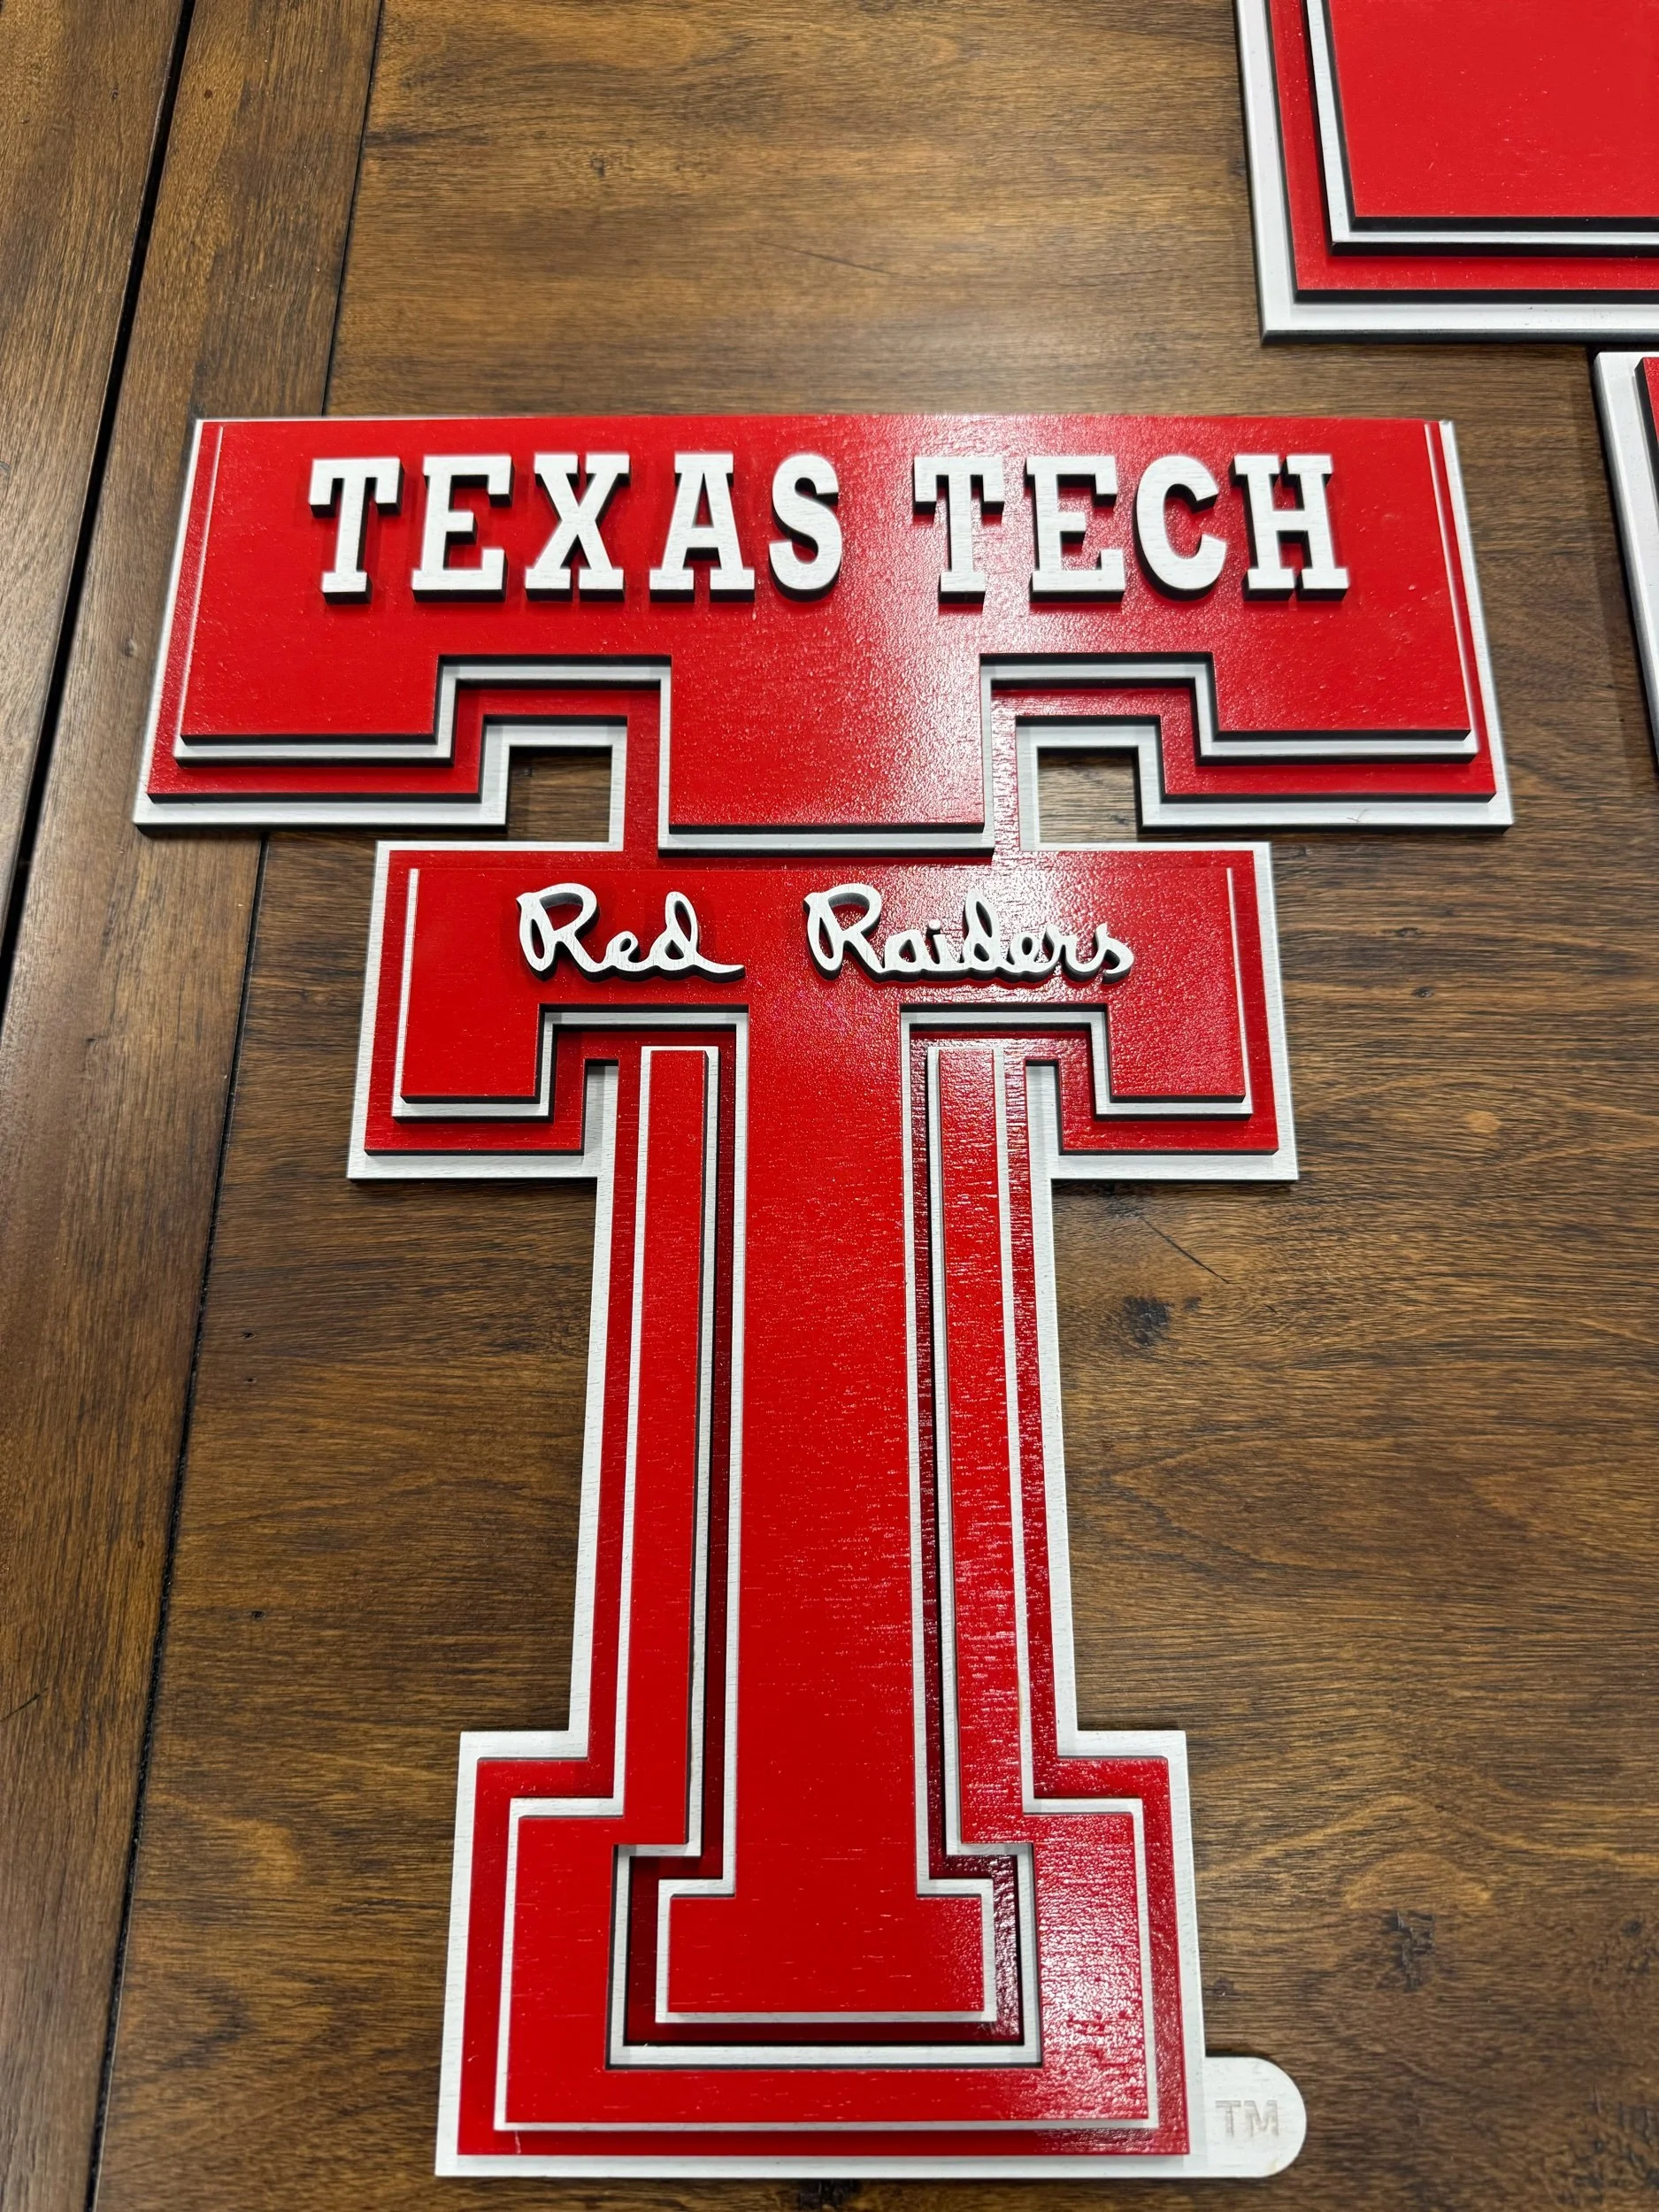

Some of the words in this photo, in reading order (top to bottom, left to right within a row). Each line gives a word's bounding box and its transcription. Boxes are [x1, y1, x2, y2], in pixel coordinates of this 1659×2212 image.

[308, 452, 844, 599] TEXAS
[912, 454, 1350, 602] TECH
[516, 883, 744, 980] Red
[803, 882, 1135, 980] Raiders
[1215, 2100, 1280, 2139] TM
